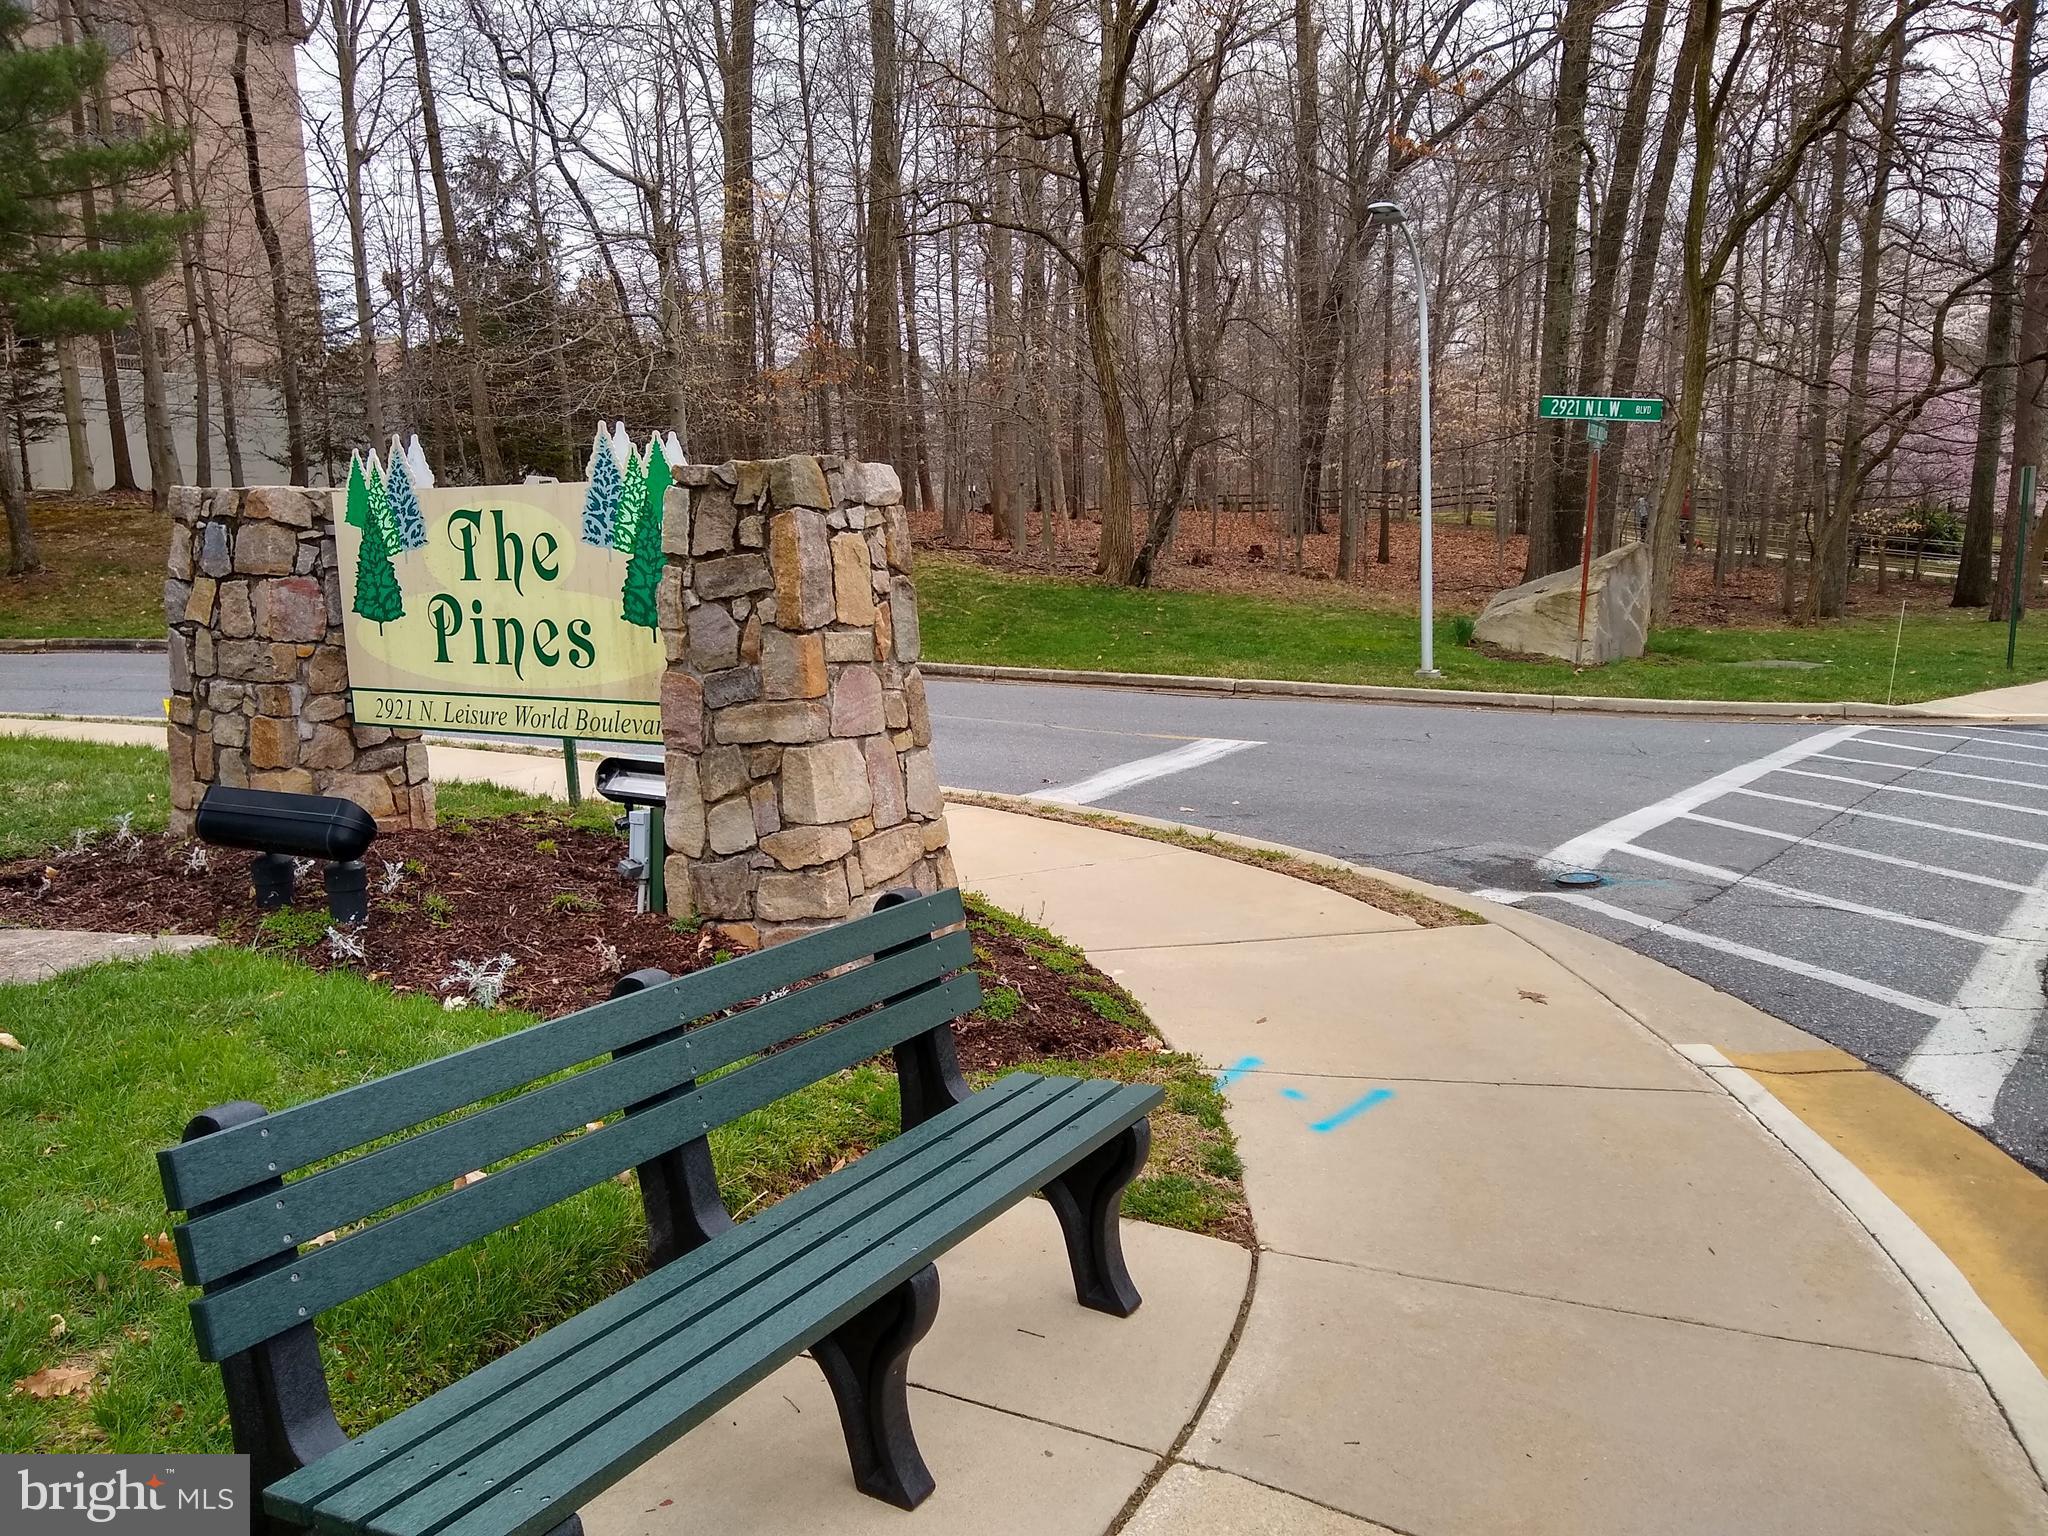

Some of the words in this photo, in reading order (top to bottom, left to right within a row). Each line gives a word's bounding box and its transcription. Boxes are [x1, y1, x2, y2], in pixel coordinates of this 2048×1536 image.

[1550, 399, 1579, 416] 2921
[1635, 405, 1652, 415] BLVD
[447, 508, 560, 597] The
[427, 593, 597, 682] Pines
[375, 697, 413, 721] 2921
[419, 699, 438, 723] N.
[443, 701, 508, 727] Leisure
[514, 704, 569, 730] World
[575, 708, 662, 736] Boulevar
